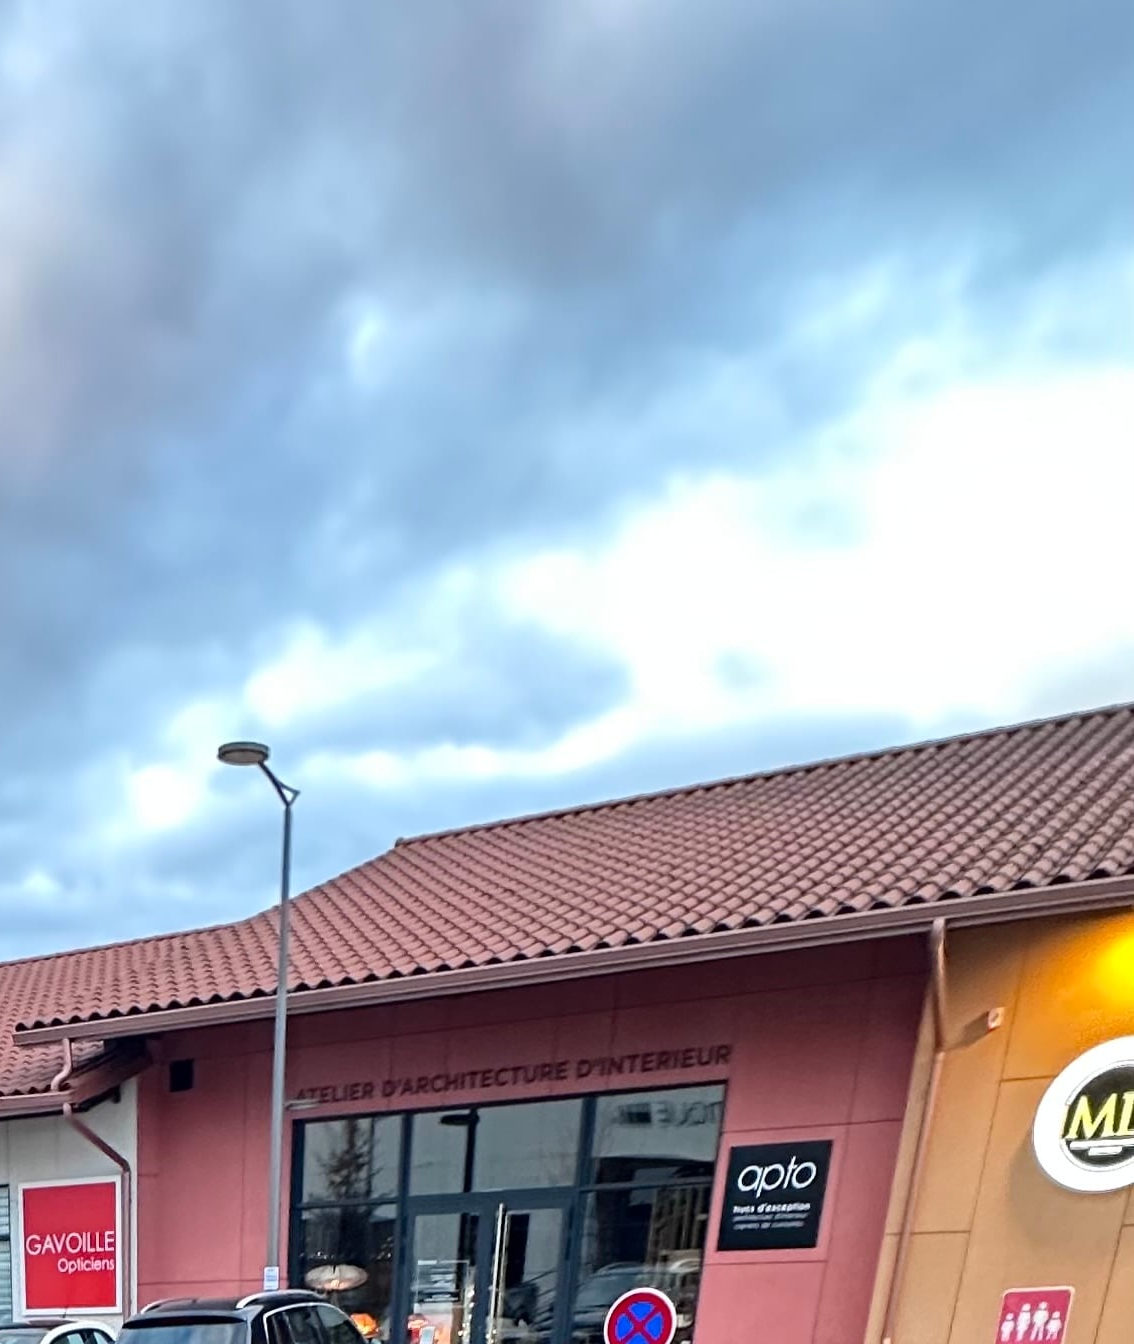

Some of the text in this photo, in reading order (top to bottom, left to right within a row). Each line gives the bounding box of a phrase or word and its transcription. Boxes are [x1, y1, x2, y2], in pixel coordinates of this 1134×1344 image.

[297, 1044, 733, 1103] ATELIER D'ARCHITECTURE D'INTERIEUR
[737, 1155, 817, 1199] apto
[26, 1230, 115, 1255] GAVOILLE
[57, 1256, 115, 1275] Opticiens
